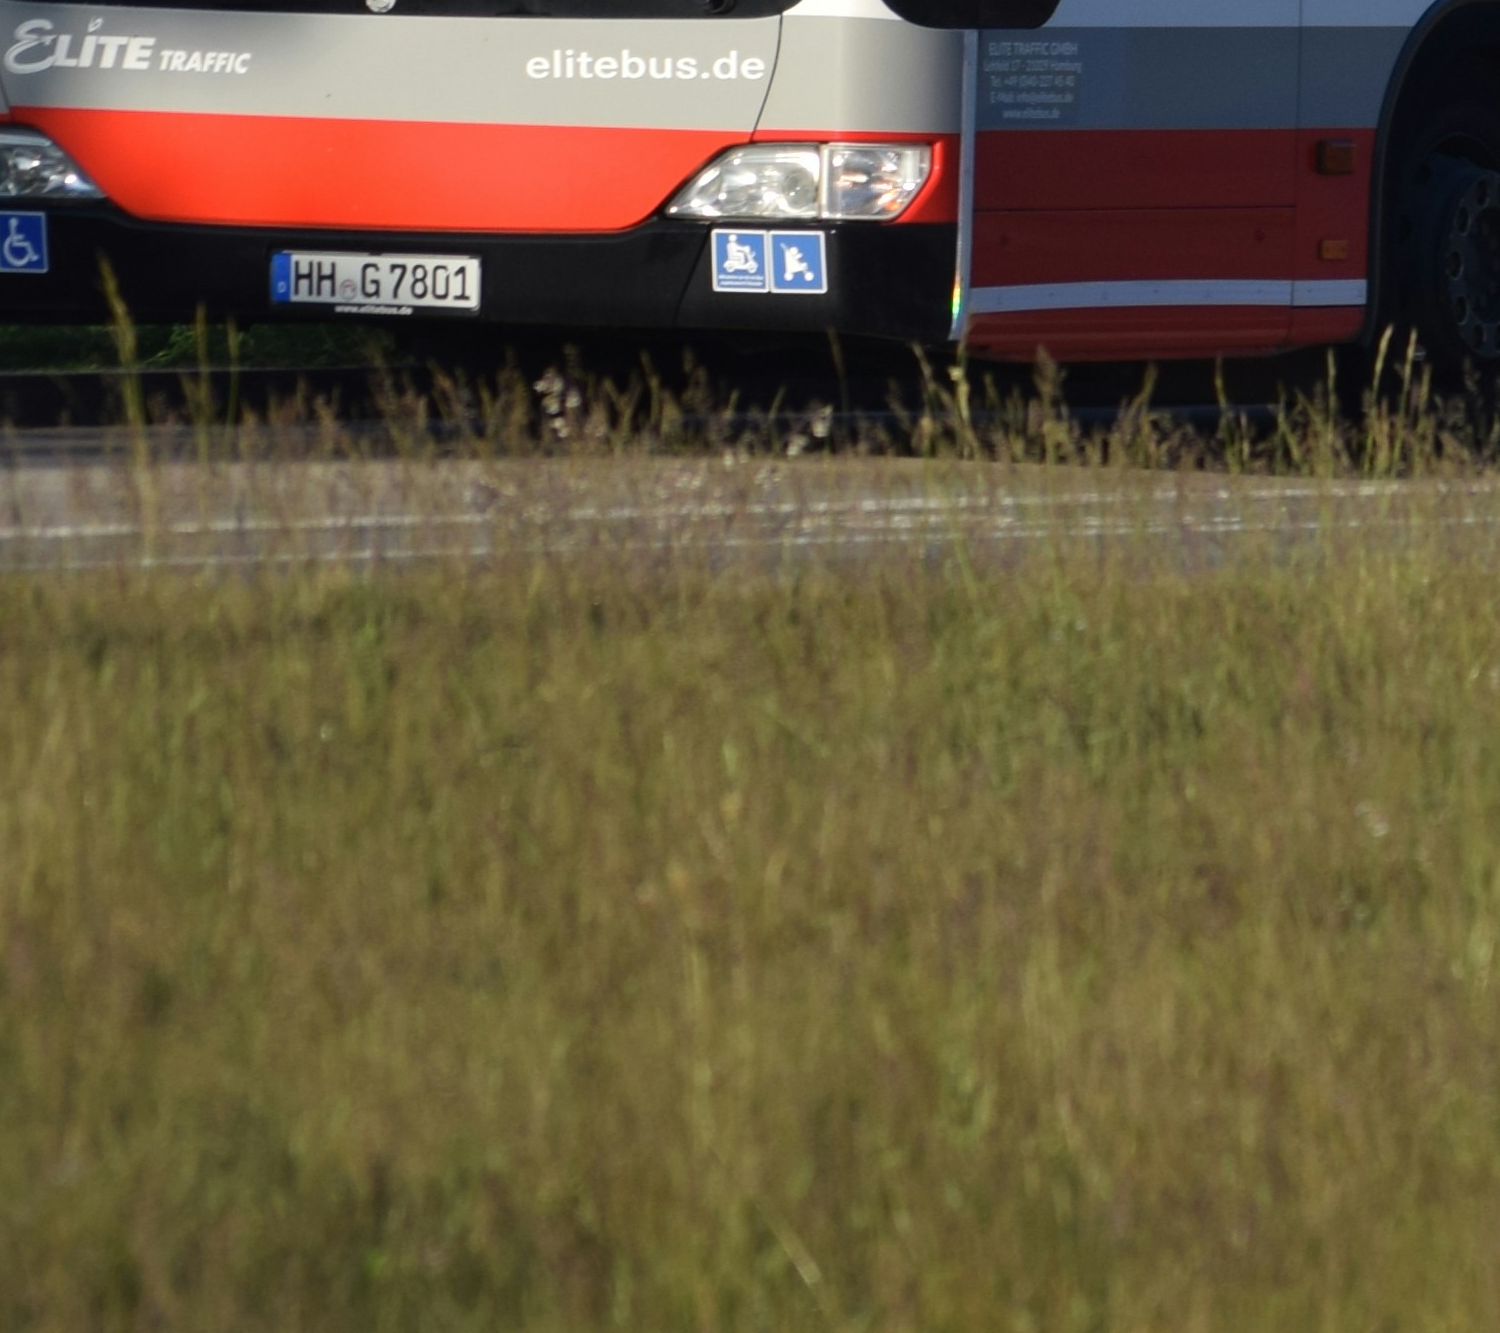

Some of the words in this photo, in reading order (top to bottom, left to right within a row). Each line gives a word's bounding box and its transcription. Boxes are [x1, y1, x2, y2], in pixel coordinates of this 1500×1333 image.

[159, 49, 252, 75] TRAFFIC
[525, 49, 766, 80] elitebus.de
[294, 260, 336, 298] HH
